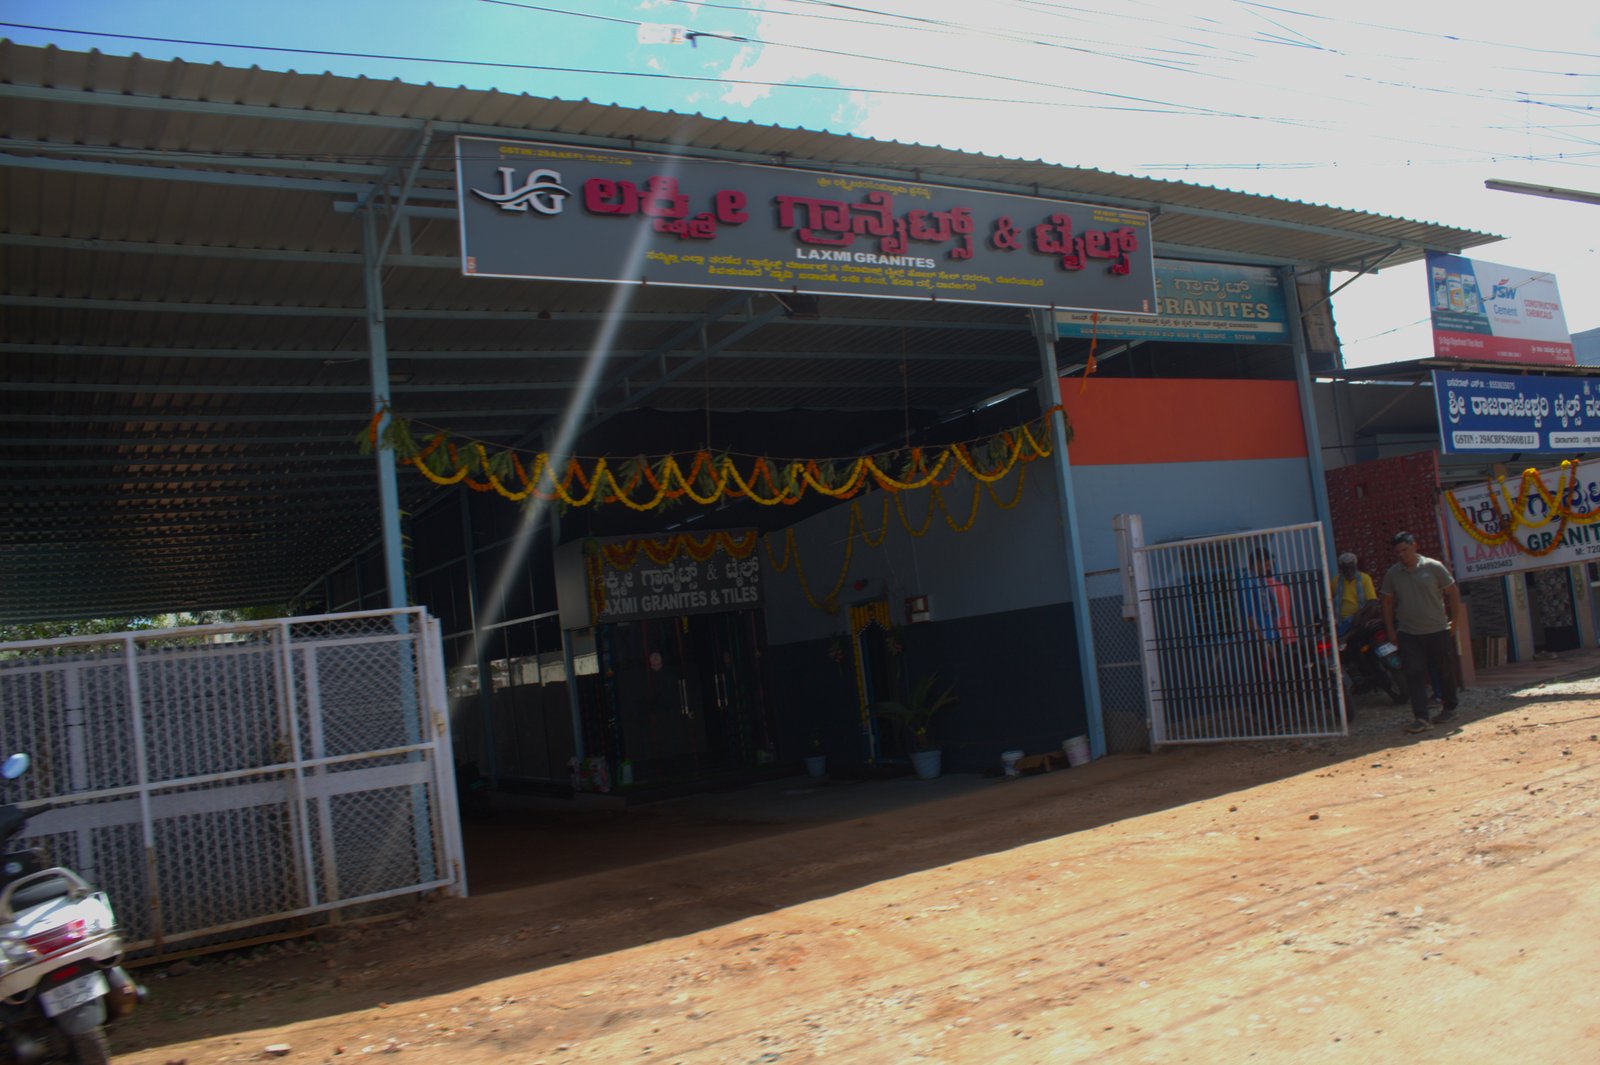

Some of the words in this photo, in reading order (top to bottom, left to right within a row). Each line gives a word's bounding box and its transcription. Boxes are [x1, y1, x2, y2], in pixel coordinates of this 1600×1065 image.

[993, 215, 1023, 249] &
[1035, 213, 1138, 276] ಟೈಲ್ಸ್
[796, 248, 851, 262] LAXMI
[853, 252, 936, 269] GRANITES
[1490, 285, 1517, 300] JSW
[1493, 303, 1519, 318] Cement
[1455, 434, 1475, 444] GSTIN
[706, 563, 719, 581] &
[604, 597, 638, 616] AXMI
[642, 591, 707, 612] GRANITES
[711, 590, 721, 605] &
[722, 587, 758, 604] TILES
